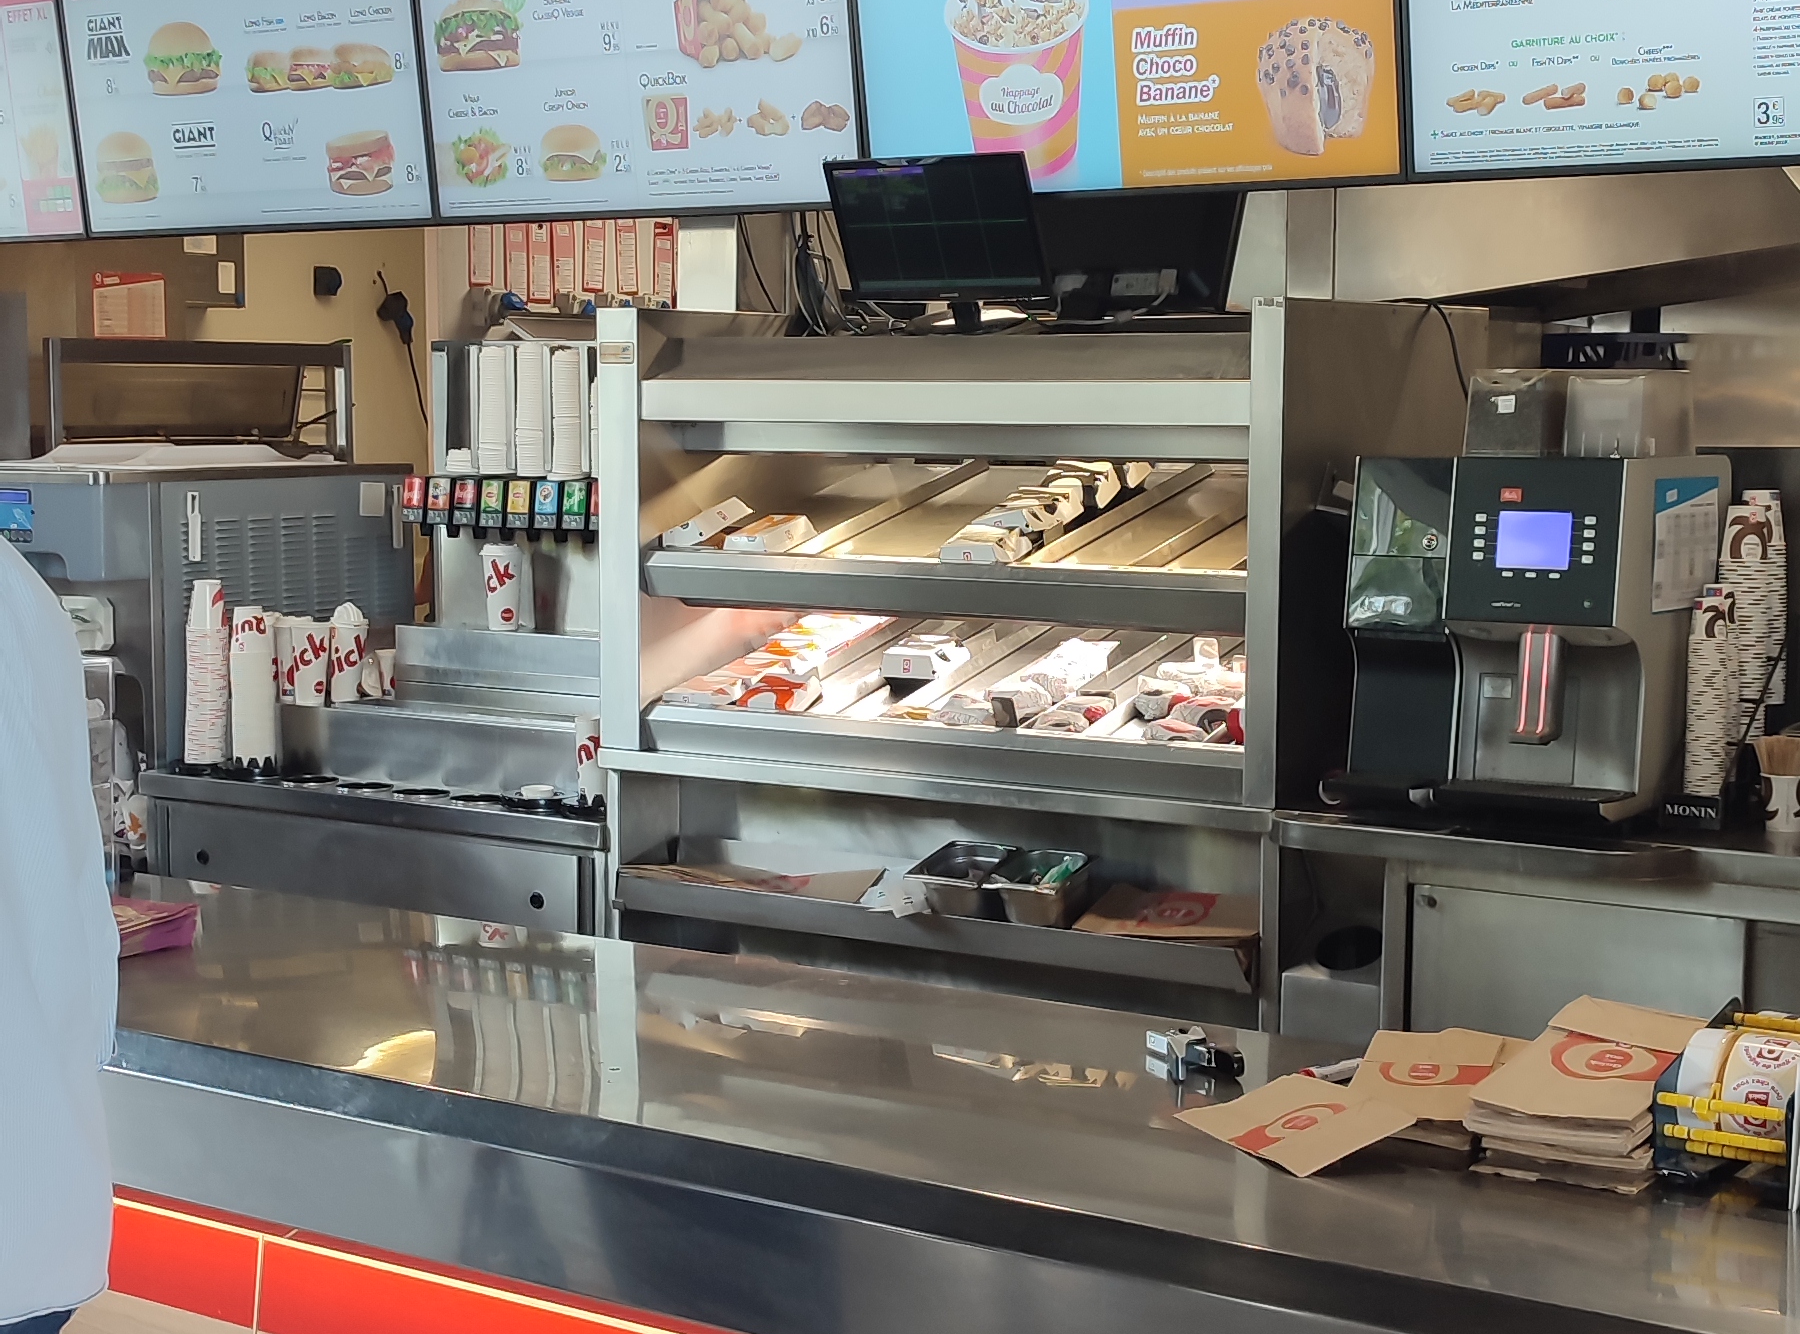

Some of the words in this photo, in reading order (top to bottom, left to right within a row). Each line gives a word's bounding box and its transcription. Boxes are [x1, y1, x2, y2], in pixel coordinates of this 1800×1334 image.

[87, 16, 123, 32] GIANT
[1134, 27, 1195, 50] Muffin
[1511, 35, 1566, 49] GARNITURE
[1568, 35, 1581, 46] AU
[87, 35, 131, 61] MAX
[1135, 57, 1194, 76] Choco
[990, 102, 1005, 114] au
[1008, 95, 1053, 114] Chocolat
[1177, 113, 1186, 122] LA
[173, 127, 215, 144] GIANT
[1665, 803, 1717, 818] MONIN
